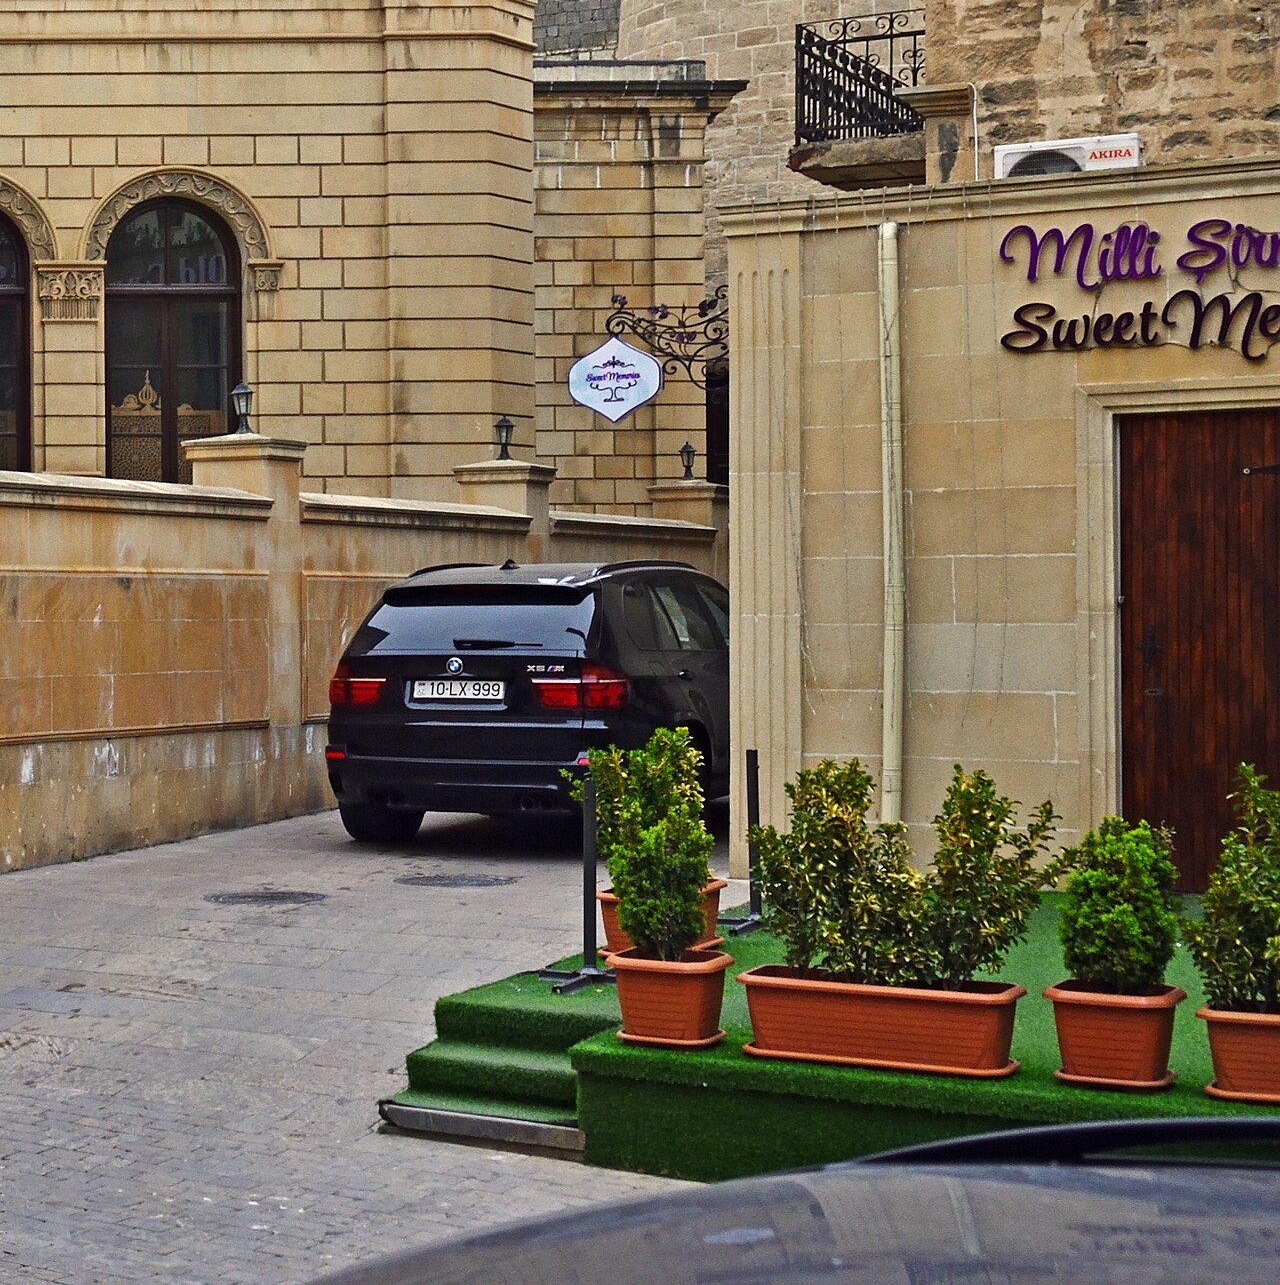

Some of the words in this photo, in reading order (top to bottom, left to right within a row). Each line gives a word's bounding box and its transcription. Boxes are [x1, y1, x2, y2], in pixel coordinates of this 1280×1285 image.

[1089, 148, 1133, 161] AKIRA
[999, 222, 1162, 291] Milli
[1000, 301, 1159, 350] Sweet
